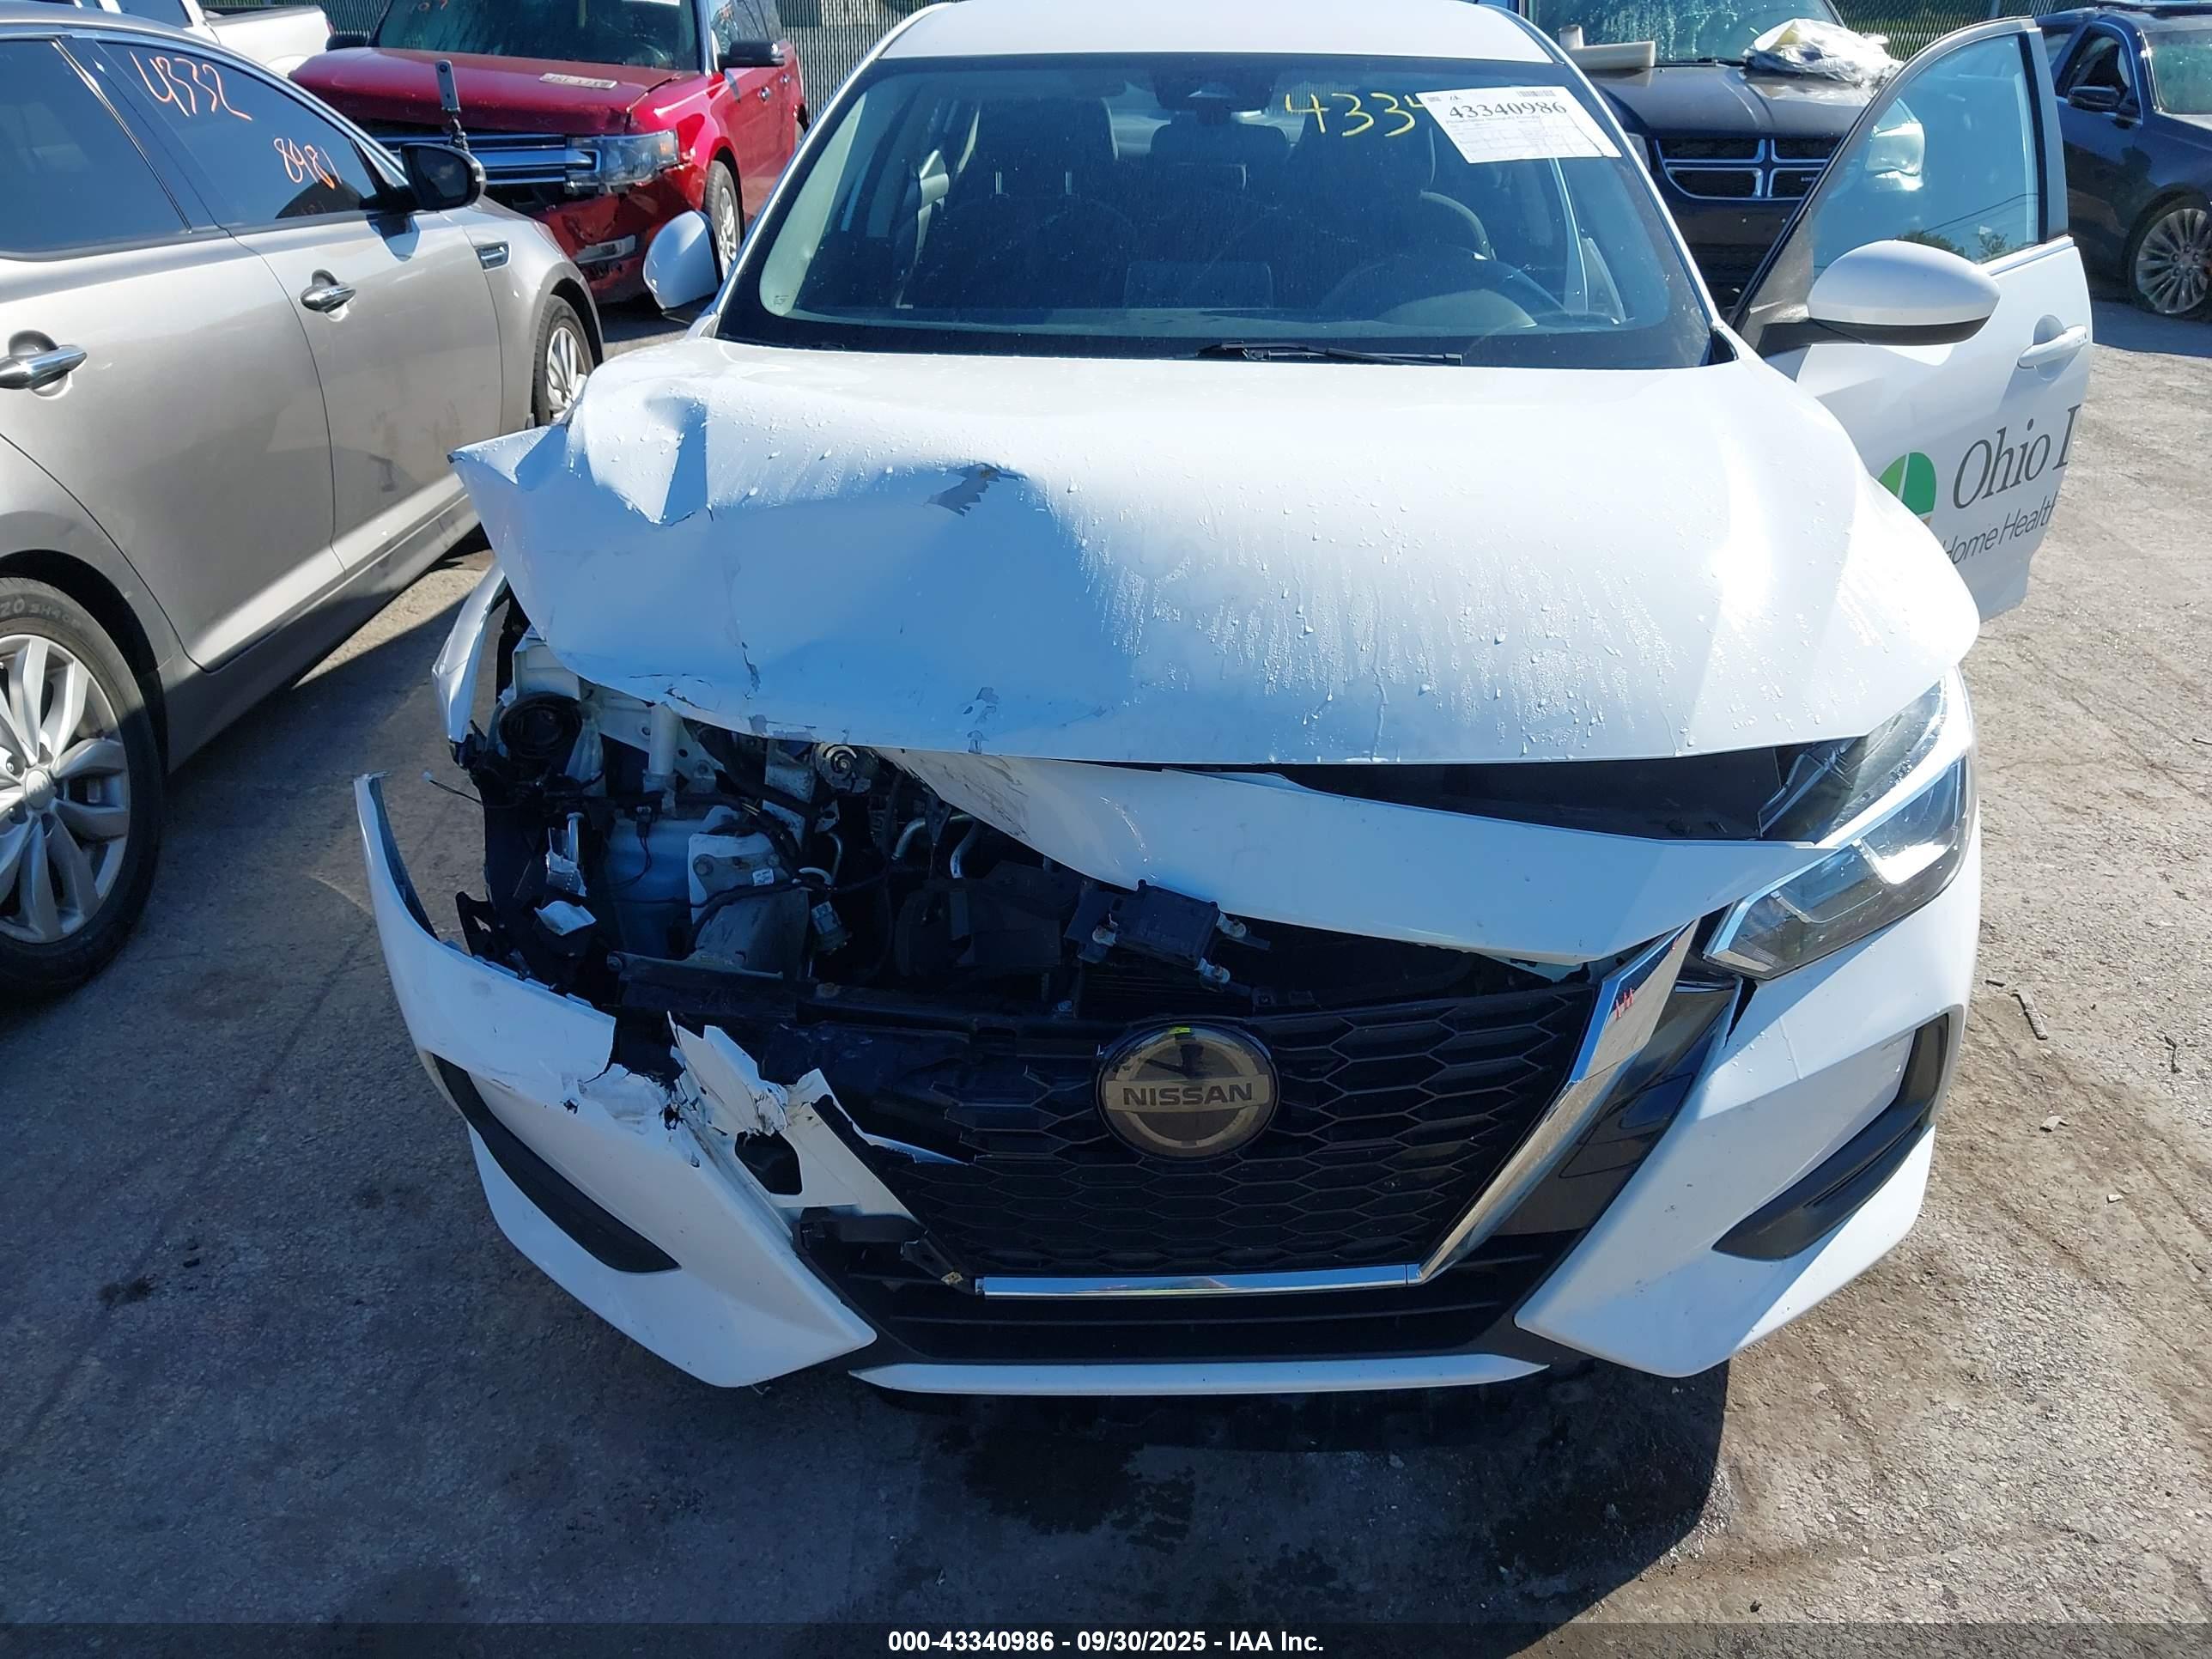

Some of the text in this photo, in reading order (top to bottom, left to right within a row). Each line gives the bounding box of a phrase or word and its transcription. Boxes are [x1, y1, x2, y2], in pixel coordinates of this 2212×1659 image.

[1449, 101, 1567, 118] 43340986
[1953, 417, 2051, 509] Ohio
[1122, 1083, 1253, 1107] NISSAN
